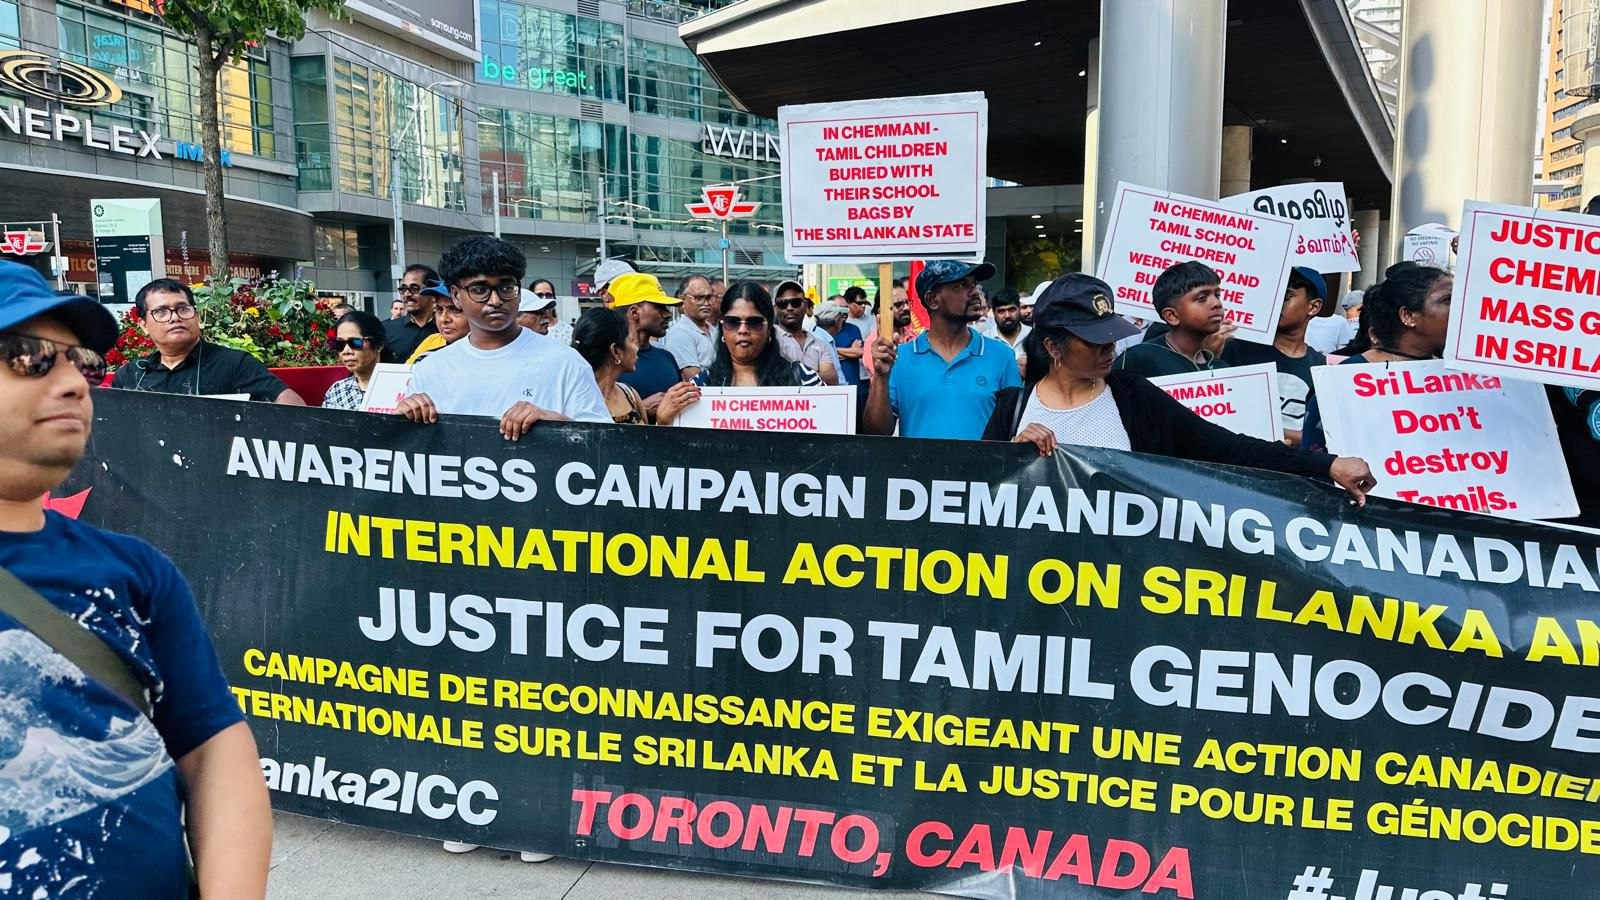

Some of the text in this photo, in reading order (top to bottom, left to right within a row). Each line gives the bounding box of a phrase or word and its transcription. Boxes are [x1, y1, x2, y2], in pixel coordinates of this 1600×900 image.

[431, 18, 473, 42] samsung.com
[484, 54, 594, 91] be great.
[0, 105, 233, 168] NEPLEX IMX
[706, 124, 781, 162] WIN
[823, 127, 838, 140] IN
[841, 122, 931, 139] CHEMMANI
[815, 142, 948, 161] TAMIL CHILDREN
[829, 164, 933, 181] BURIED WITH
[824, 184, 940, 201] THEIR SCHOOL
[848, 206, 914, 220] BAGS BY
[1153, 200, 1170, 214] IN
[1171, 204, 1254, 232] CHEMMANI
[795, 224, 974, 241] THE SRI LANKAN STATE
[1149, 218, 1256, 251] TAMIL SCHOOL
[1490, 219, 1600, 255] JUSTIC
[1160, 239, 1236, 265] CHILDREN
[165, 264, 183, 275] NTER
[1129, 252, 1172, 270] WERE
[1226, 272, 1260, 288] AND
[1489, 256, 1600, 296] CHEM
[1117, 286, 1141, 303] SRI
[1224, 308, 1255, 325] ATE
[1479, 296, 1575, 332] MASS
[1475, 334, 1509, 361] IN
[1512, 340, 1567, 369] SRI
[1165, 383, 1225, 401] MMANI
[1352, 370, 1502, 397] Sri Lanka
[711, 400, 726, 412] IN
[729, 399, 810, 412] CHEMMANI
[1190, 402, 1237, 417] HOOL
[710, 417, 817, 430] TAMIL SCHOOL
[1391, 406, 1482, 434] Don’t
[1384, 448, 1509, 476] destroy
[227, 436, 1600, 592] AWARENESS CAMPAIGN DEMANDING CANADIA
[325, 510, 766, 583] INTERNATIONAL
[782, 542, 1009, 600] ACTION
[1028, 558, 1121, 609] ON
[1140, 566, 1247, 617] SRI
[1255, 580, 1504, 659] LANKA
[358, 586, 1600, 753] JUSTICE FOR TAMIL GENOCIDE
[243, 648, 430, 699] CAMPAGNE
[439, 673, 488, 706] DE
[494, 679, 855, 735] RECONNAISSANCE
[867, 706, 1080, 754] EXIGEANT
[1092, 726, 1182, 766] UNE
[1193, 739, 1362, 782] ACTION
[229, 686, 1600, 855] TERNATIONALE SUR LE SRI LANKA ET LA JUSTICE POUR LE GÉNOCIDE
[259, 756, 499, 826] anka2ICC
[571, 789, 892, 877] TORONTO,
[905, 820, 1195, 899] CANADA
